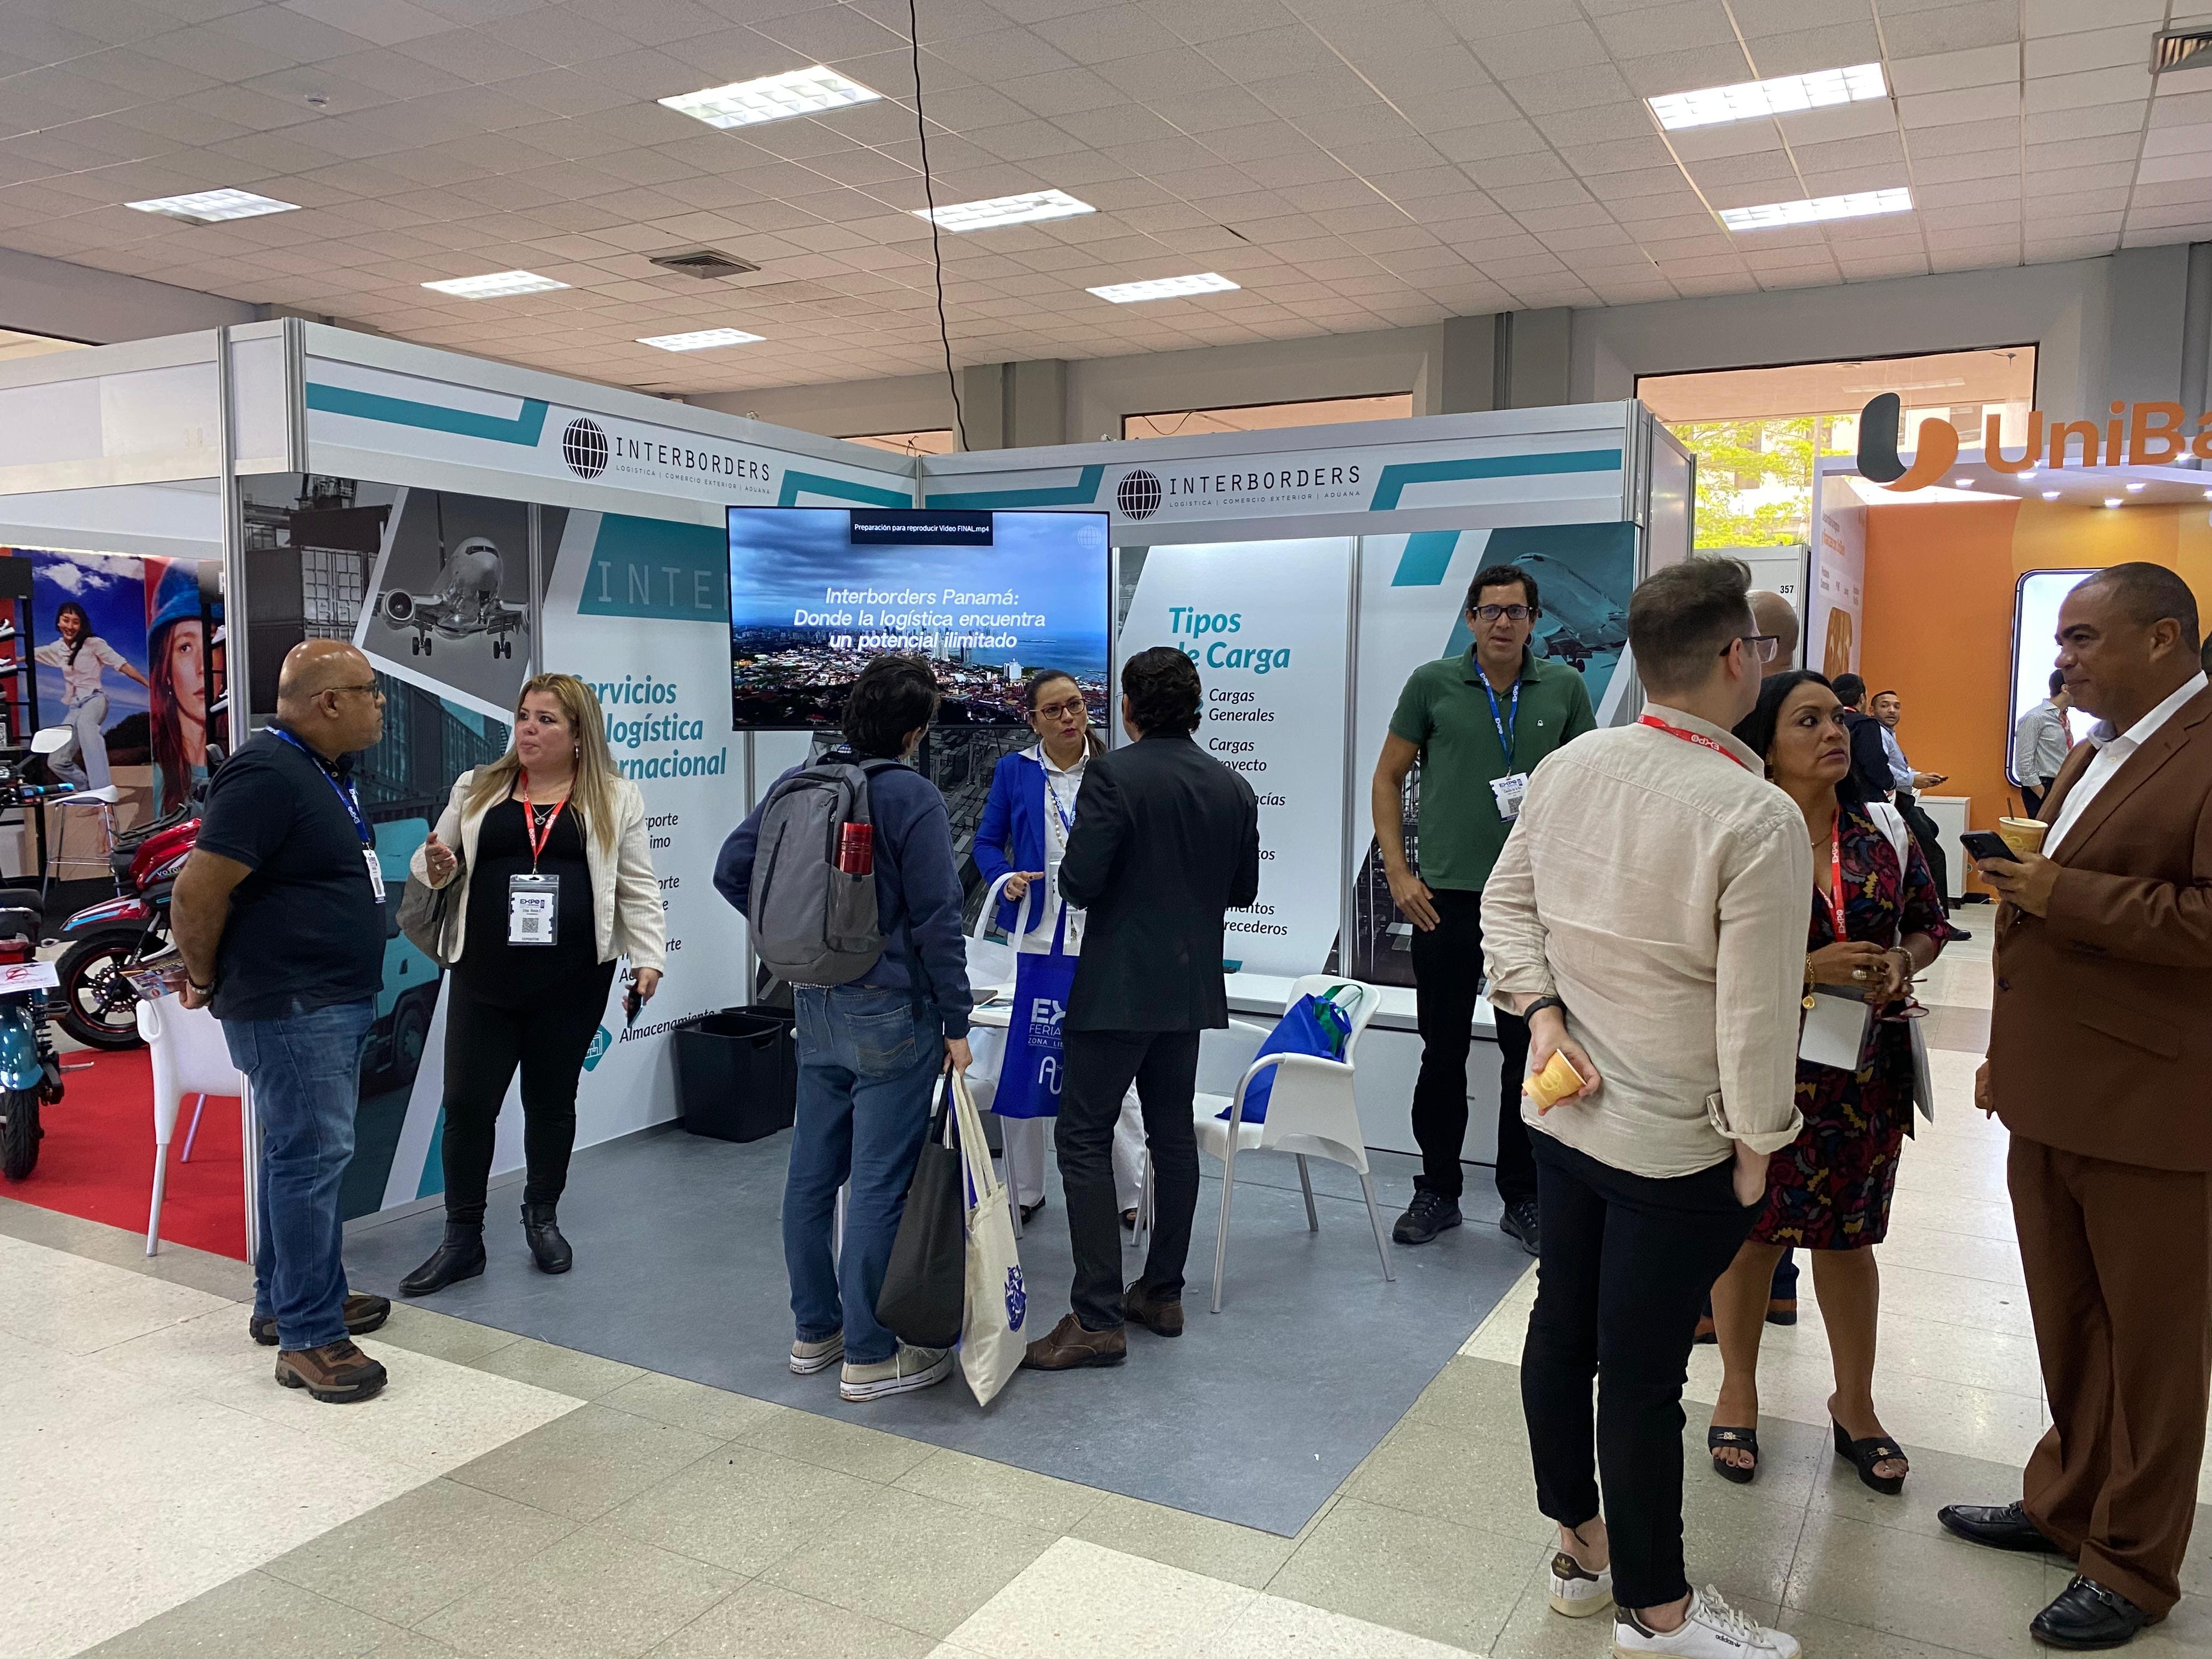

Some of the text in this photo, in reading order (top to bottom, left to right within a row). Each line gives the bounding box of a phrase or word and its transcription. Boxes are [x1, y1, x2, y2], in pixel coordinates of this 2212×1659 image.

[616, 437, 770, 482] INTERBORDERS
[616, 465, 770, 494] LOGISTICA COMERCIO EXTERIOR ADUANA
[1170, 465, 1360, 495] INTERBORDERS
[854, 523, 891, 532] Preparación
[597, 561, 729, 610] INTE
[1780, 585, 1794, 594] 357
[826, 588, 1019, 605] Interborders Panamá:
[794, 609, 1045, 630] Donde la logística encuentra
[1169, 606, 1242, 639] Tipos
[830, 630, 1018, 652] un potencial ilimitado
[1207, 641, 1290, 674] Carga
[1209, 689, 1255, 704] Cargas
[1209, 708, 1275, 721] Generales
[606, 713, 703, 748] logística
[1209, 737, 1255, 754] Cargas
[1691, 734, 1720, 751] EXPO
[619, 747, 726, 780] rnacional
[645, 812, 678, 831] porte
[1224, 920, 1288, 935] recederos
[1029, 1023, 1062, 1036] FERIA
[1028, 1037, 1048, 1046] ZONA
[1715, 1634, 1734, 1645] adidas
